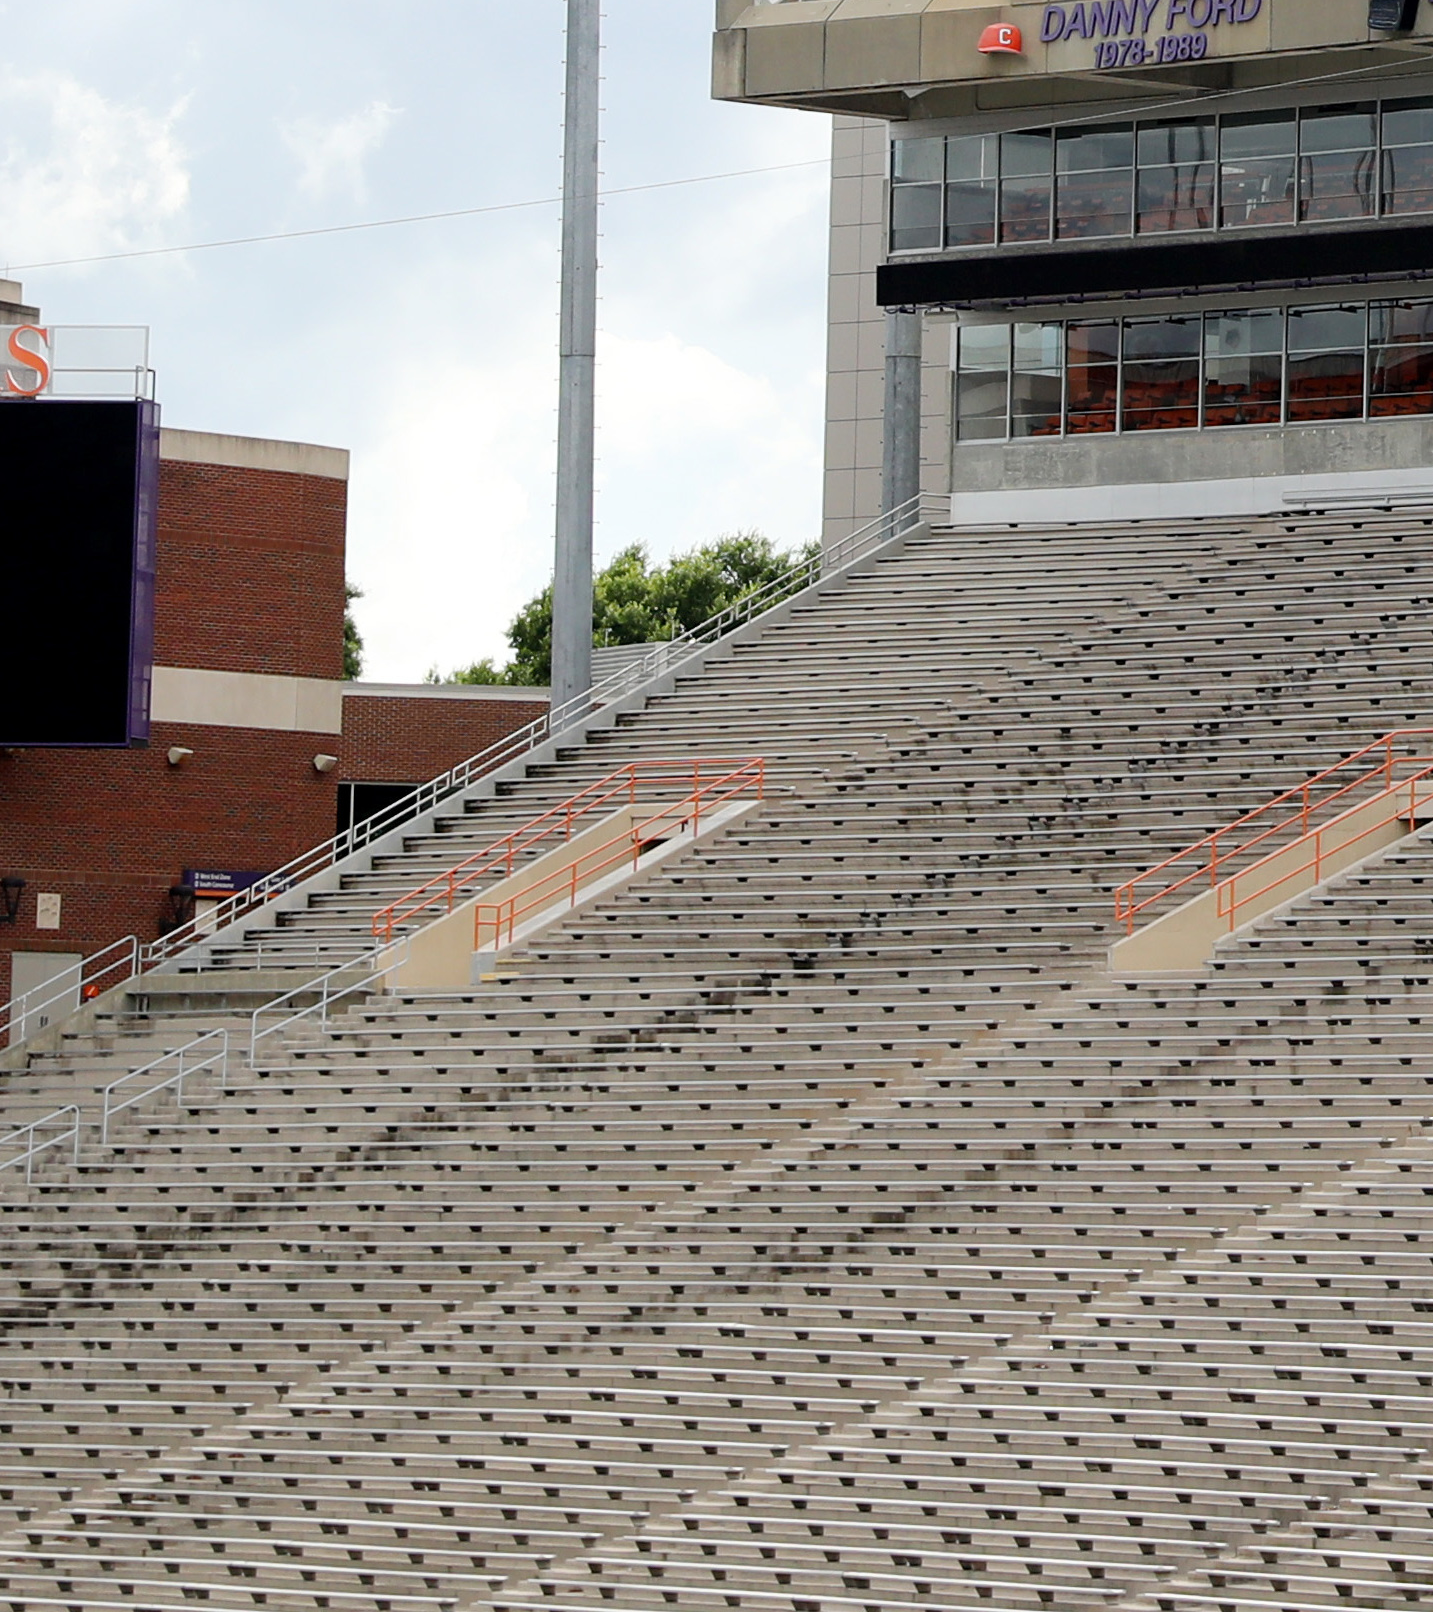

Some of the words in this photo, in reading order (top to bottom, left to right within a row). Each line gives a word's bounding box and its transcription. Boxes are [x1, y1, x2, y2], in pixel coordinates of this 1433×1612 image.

[1000, 28, 1012, 45] C
[1094, 32, 1208, 69] 1978-1989
[5, 324, 50, 396] S
